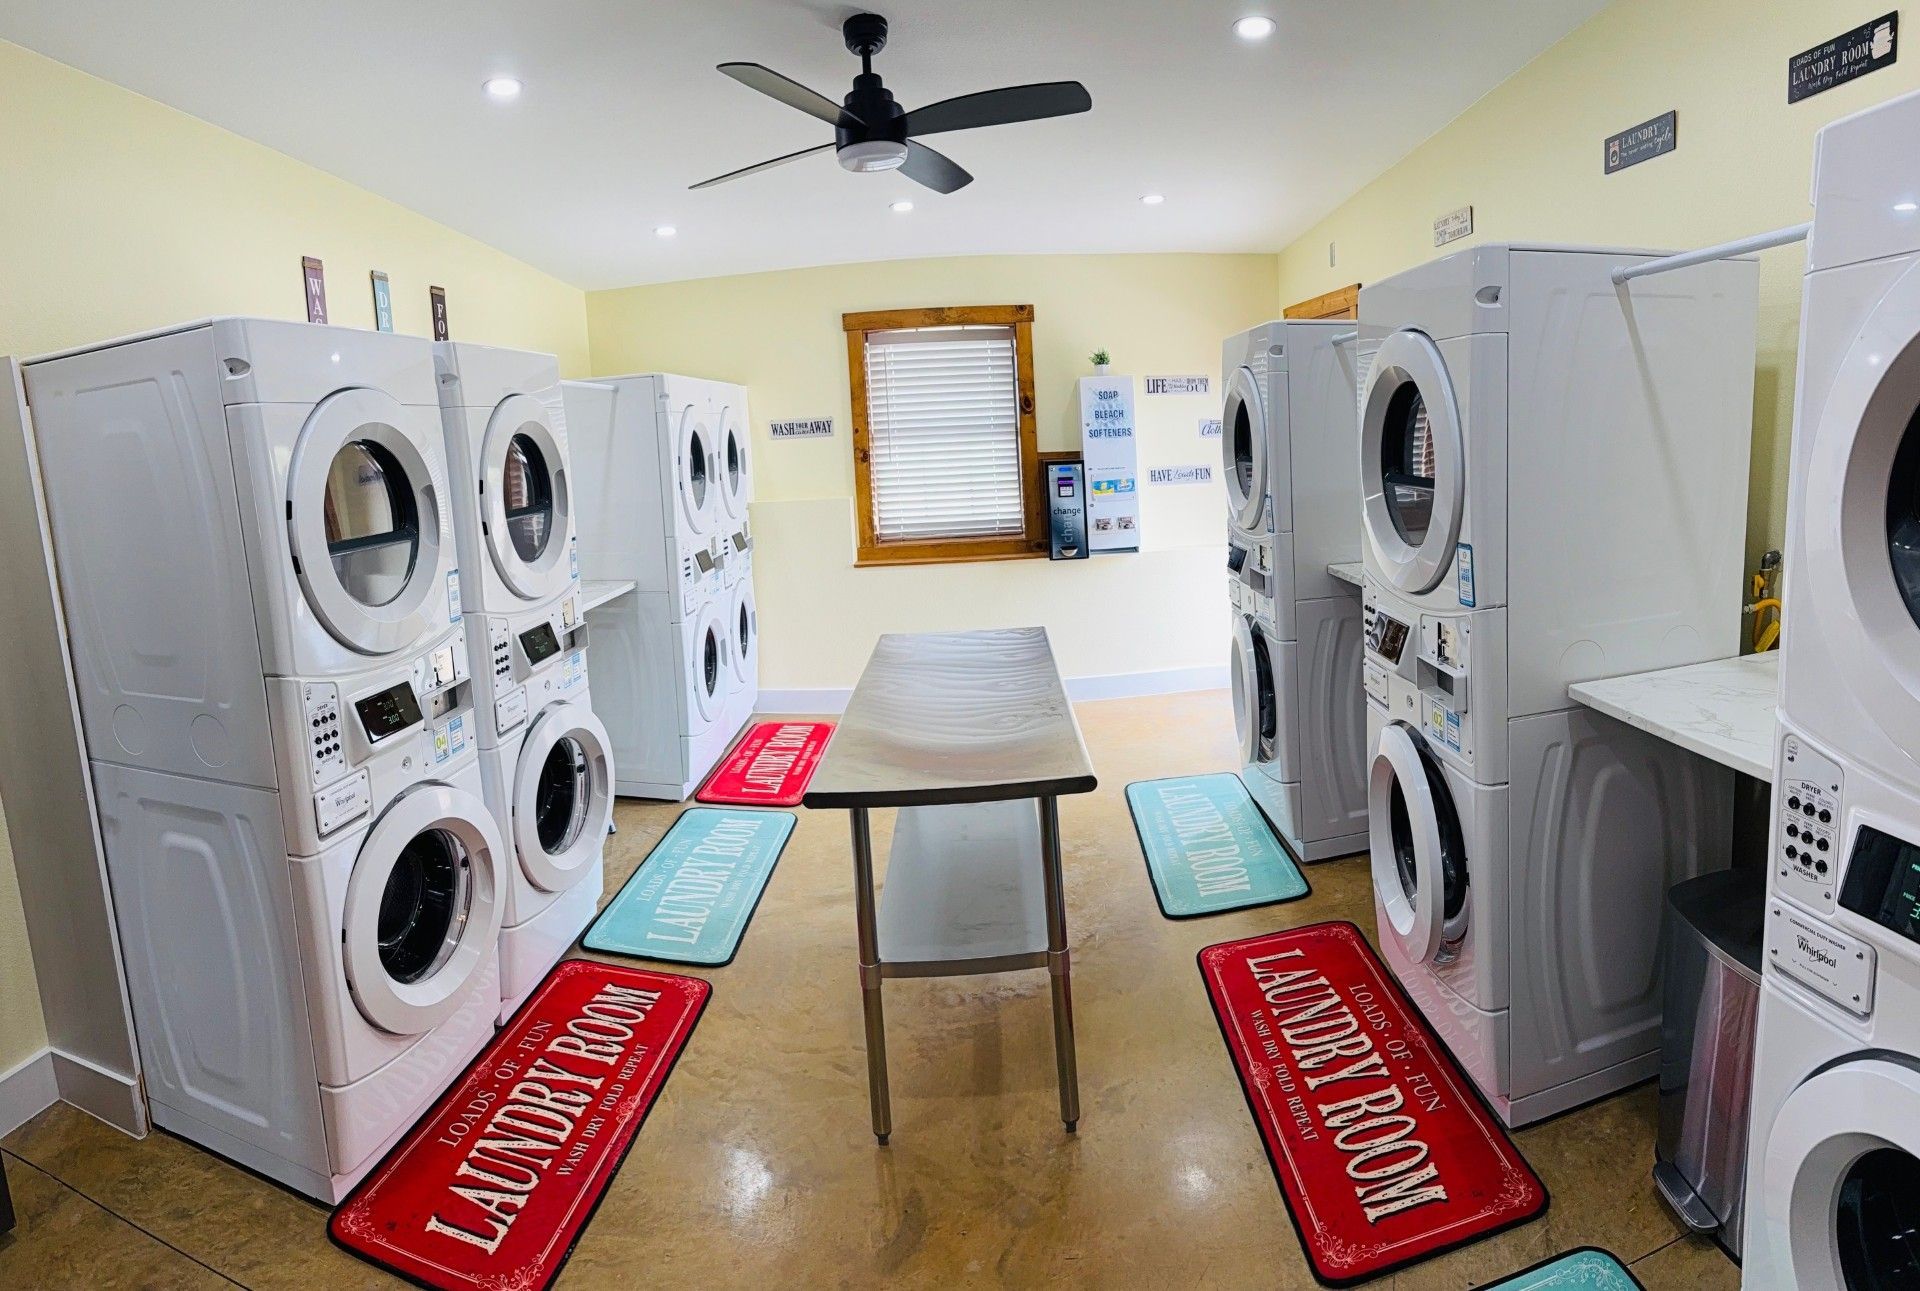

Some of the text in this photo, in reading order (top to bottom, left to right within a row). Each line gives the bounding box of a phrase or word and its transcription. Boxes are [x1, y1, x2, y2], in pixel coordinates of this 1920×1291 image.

[1792, 41, 1870, 86] LAUNDRY ROOM
[1793, 43, 1836, 69] LOADS OF FUN
[1622, 123, 1659, 149] LAUNDRY
[436, 303, 446, 341] FO
[1098, 390, 1119, 400] SOAP
[1147, 378, 1167, 393] LIFE
[1186, 384, 1208, 393] OUT
[771, 422, 795, 436] WASH
[809, 420, 832, 434] AWAY
[1094, 409, 1124, 419] BLEACH
[1088, 428, 1132, 438] SOFTENERS
[1150, 469, 1172, 482] HAVE
[1195, 467, 1211, 480] FUN
[1053, 507, 1081, 516] change
[765, 725, 816, 748] ROOM
[741, 747, 800, 794] LAUNDRY
[1801, 782, 1821, 796] DRYER
[1158, 784, 1251, 897] LAUNDRY ROOM
[636, 839, 693, 903] LOADS OF FUN
[646, 817, 764, 945] LAUNDRY ROOM
[1792, 864, 1818, 881] WASHER
[1789, 918, 1816, 936] COMMERCIAL
[1816, 932, 1829, 942] DUTY
[1829, 939, 1846, 951] WASHER
[1797, 938, 1837, 968] Whirlpool
[1246, 948, 1392, 1091] LAUNDRY
[1348, 983, 1392, 1031] LOADS
[1386, 1039, 1412, 1062] OF
[1404, 1071, 1448, 1113] FUN
[437, 1020, 555, 1149] LOADS OF FUN
[1250, 1010, 1319, 1142] WASH DRY FOLD REPEAT
[425, 983, 661, 1256] LAUNDRY ROOM
[556, 1043, 649, 1177] WASH DRY FOLD REPEAT
[1317, 1084, 1449, 1224] ROOM
